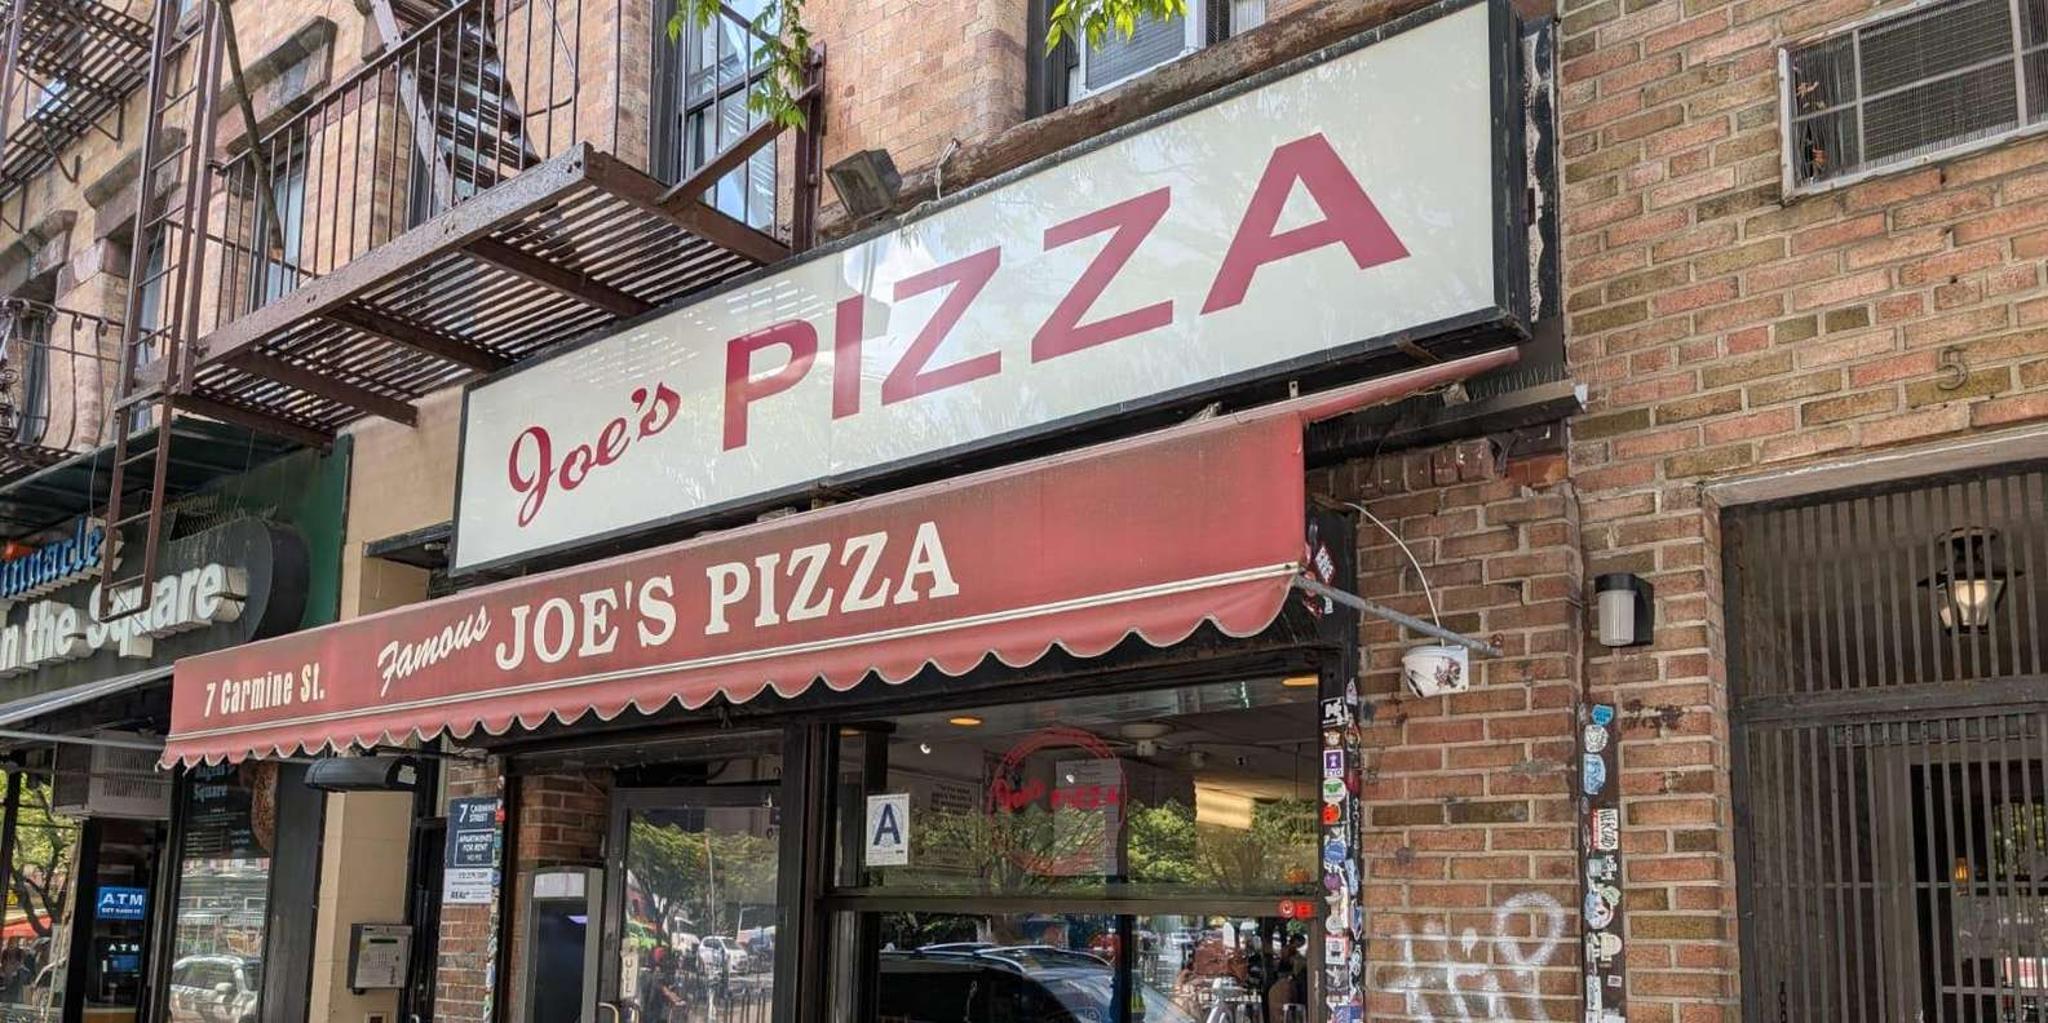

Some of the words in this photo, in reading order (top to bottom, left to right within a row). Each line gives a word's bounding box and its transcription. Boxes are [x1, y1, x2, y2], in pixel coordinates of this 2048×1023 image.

[508, 382, 681, 527] Joe's
[722, 132, 1410, 452] PIZZA
[1937, 346, 1968, 390] 5
[26, 600, 77, 664] the
[86, 563, 226, 658] Square
[496, 575, 677, 671] JOE'S
[704, 520, 960, 635] PIZZA
[377, 605, 491, 698] Famous
[203, 682, 216, 718] 7
[220, 671, 293, 715] Carmine
[301, 662, 325, 702] St.
[459, 803, 469, 823] 7
[873, 803, 901, 846] A
[103, 893, 143, 906] ATM
[108, 944, 139, 952] ATM
